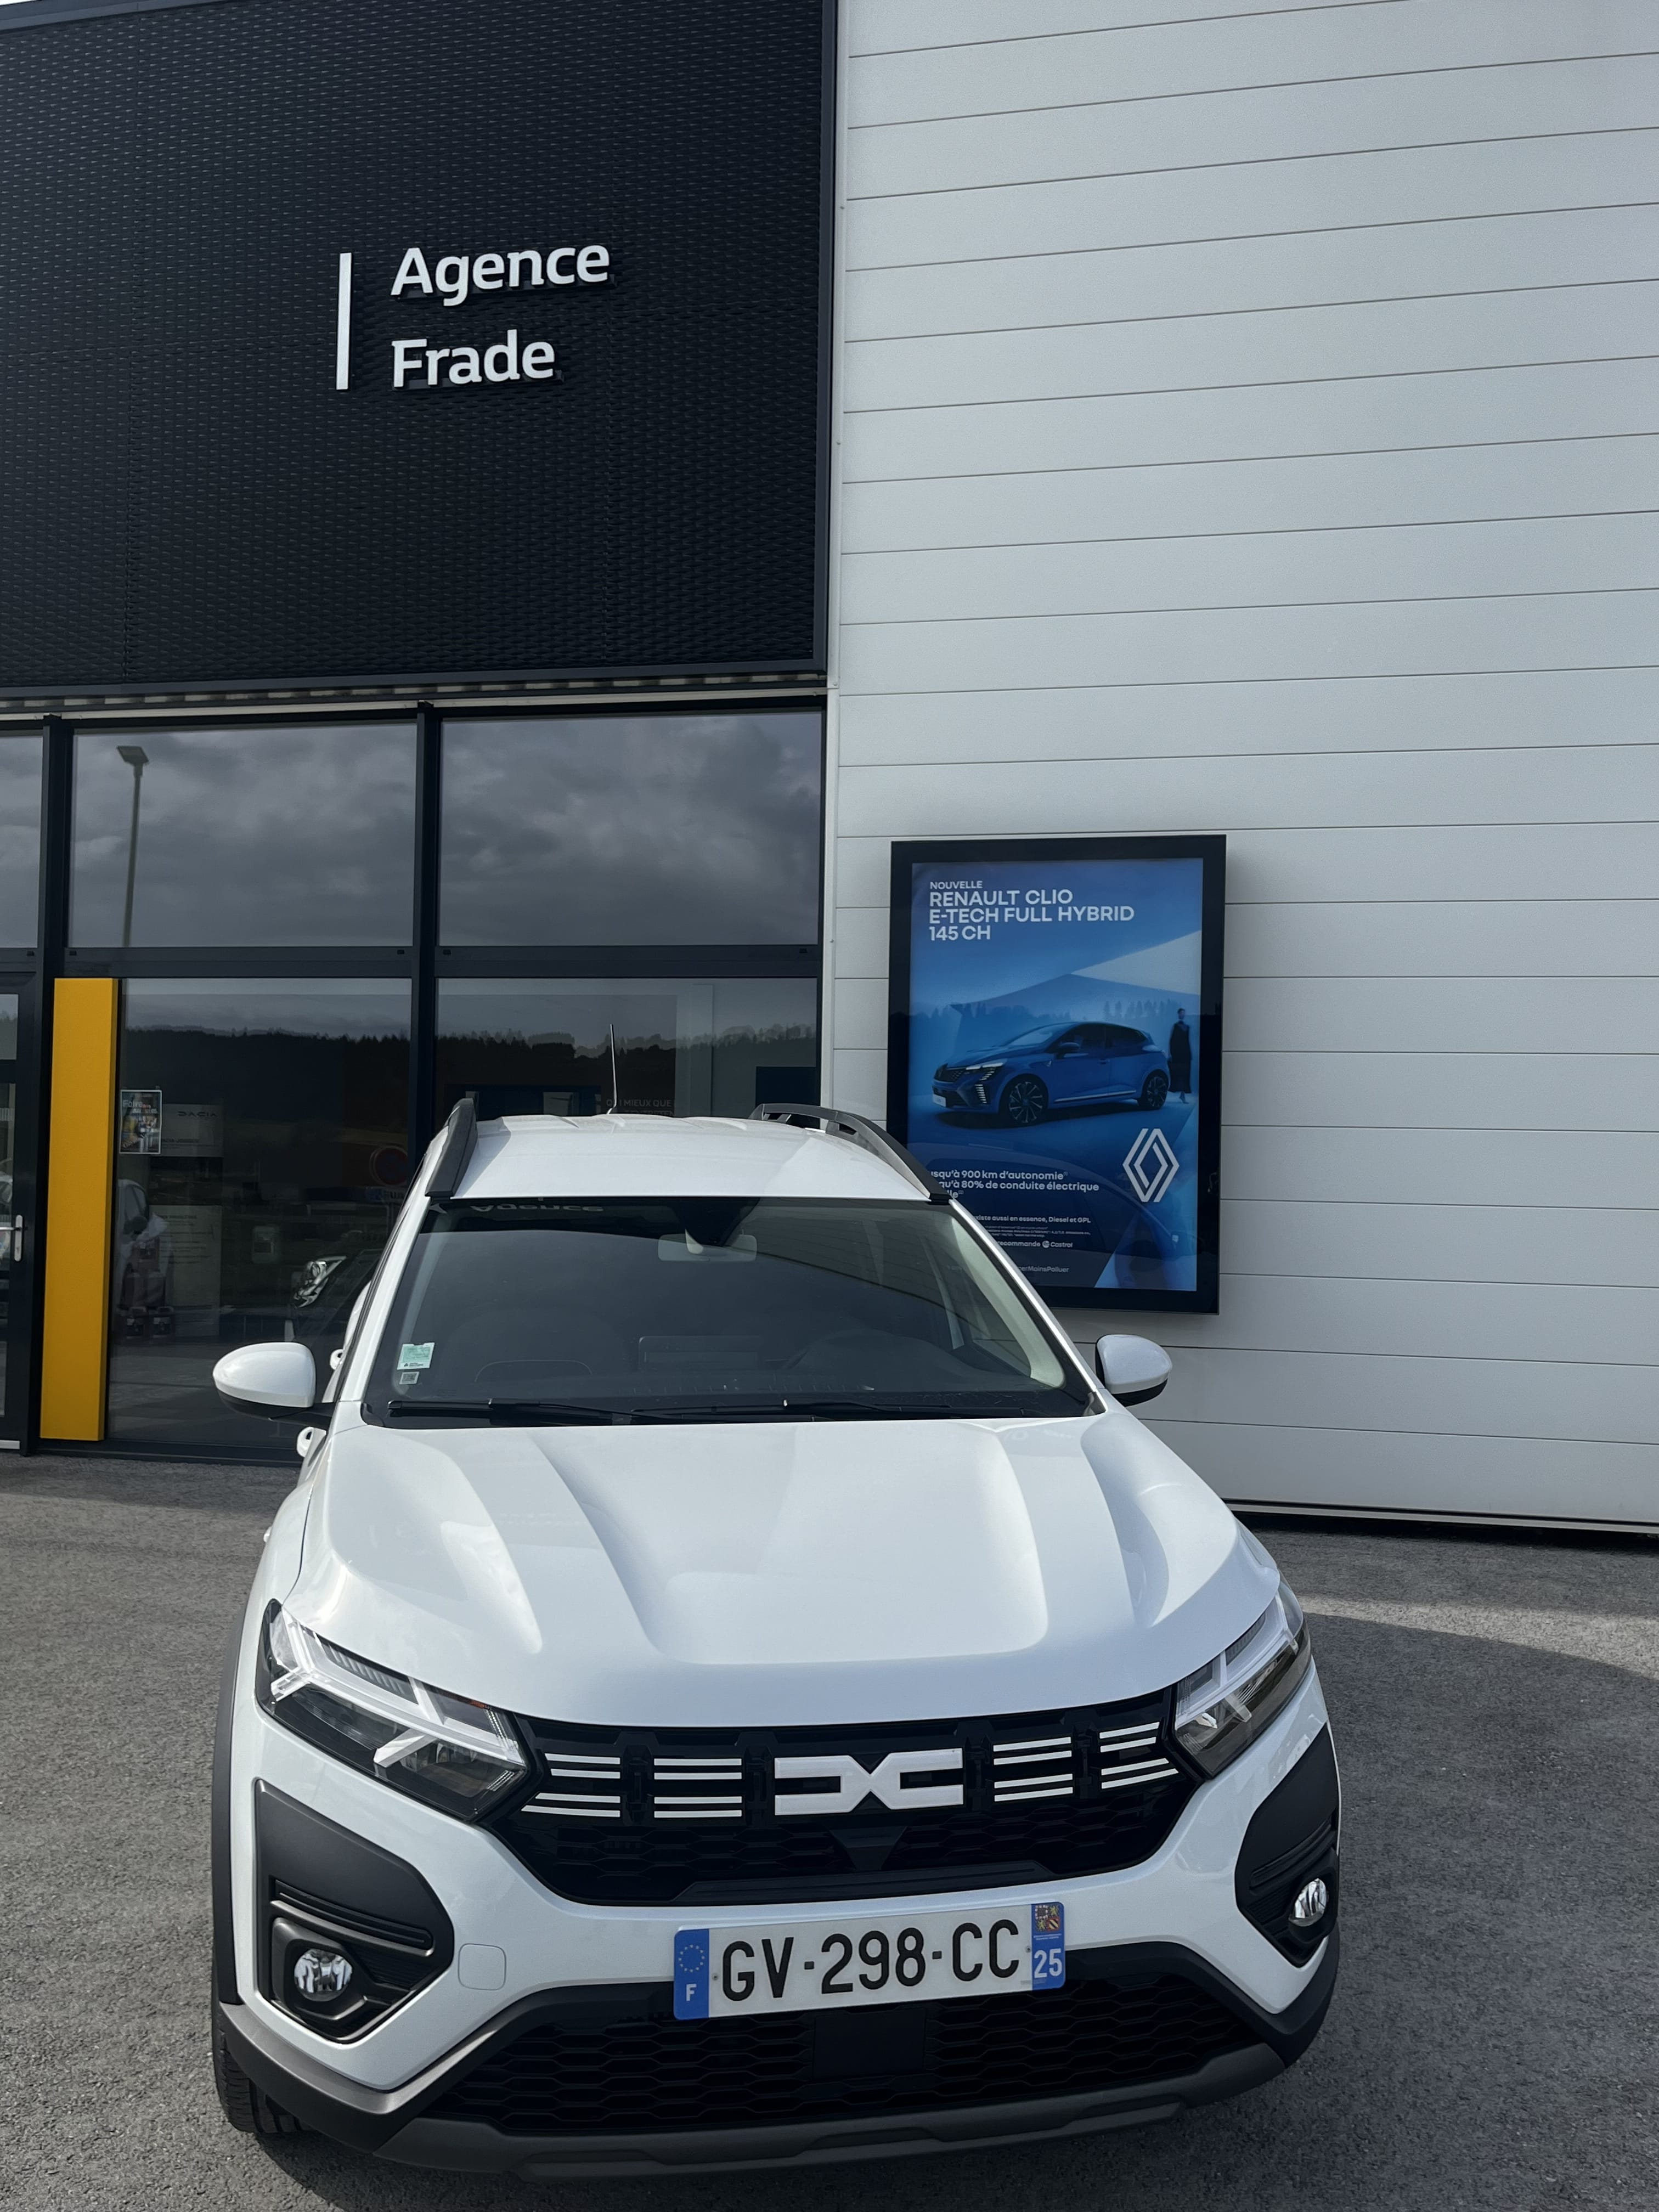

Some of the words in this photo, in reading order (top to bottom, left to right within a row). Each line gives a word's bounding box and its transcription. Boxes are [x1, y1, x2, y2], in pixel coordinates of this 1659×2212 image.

[391, 245, 610, 307] Agence
[391, 329, 555, 388] Frade
[929, 881, 983, 889] NOUVELLE
[929, 890, 1020, 907] RENAULT
[1025, 889, 1074, 905] CLIO
[929, 908, 999, 924] E-TECH
[1004, 907, 1053, 923] FULL
[1058, 906, 1135, 922] HYBRID
[929, 926, 959, 941] 145
[962, 925, 991, 940] CH
[961, 1170, 981, 1179] 900
[981, 1170, 998, 1179] km
[961, 1180, 985, 1189] 80%
[985, 1180, 998, 1189] de
[999, 1181, 1045, 1190] conduite
[1046, 1181, 1099, 1193] électrique
[722, 1918, 1020, 2002] GV-298-CC
[1033, 1948, 1063, 1979] 25
[685, 1983, 697, 2002] F
